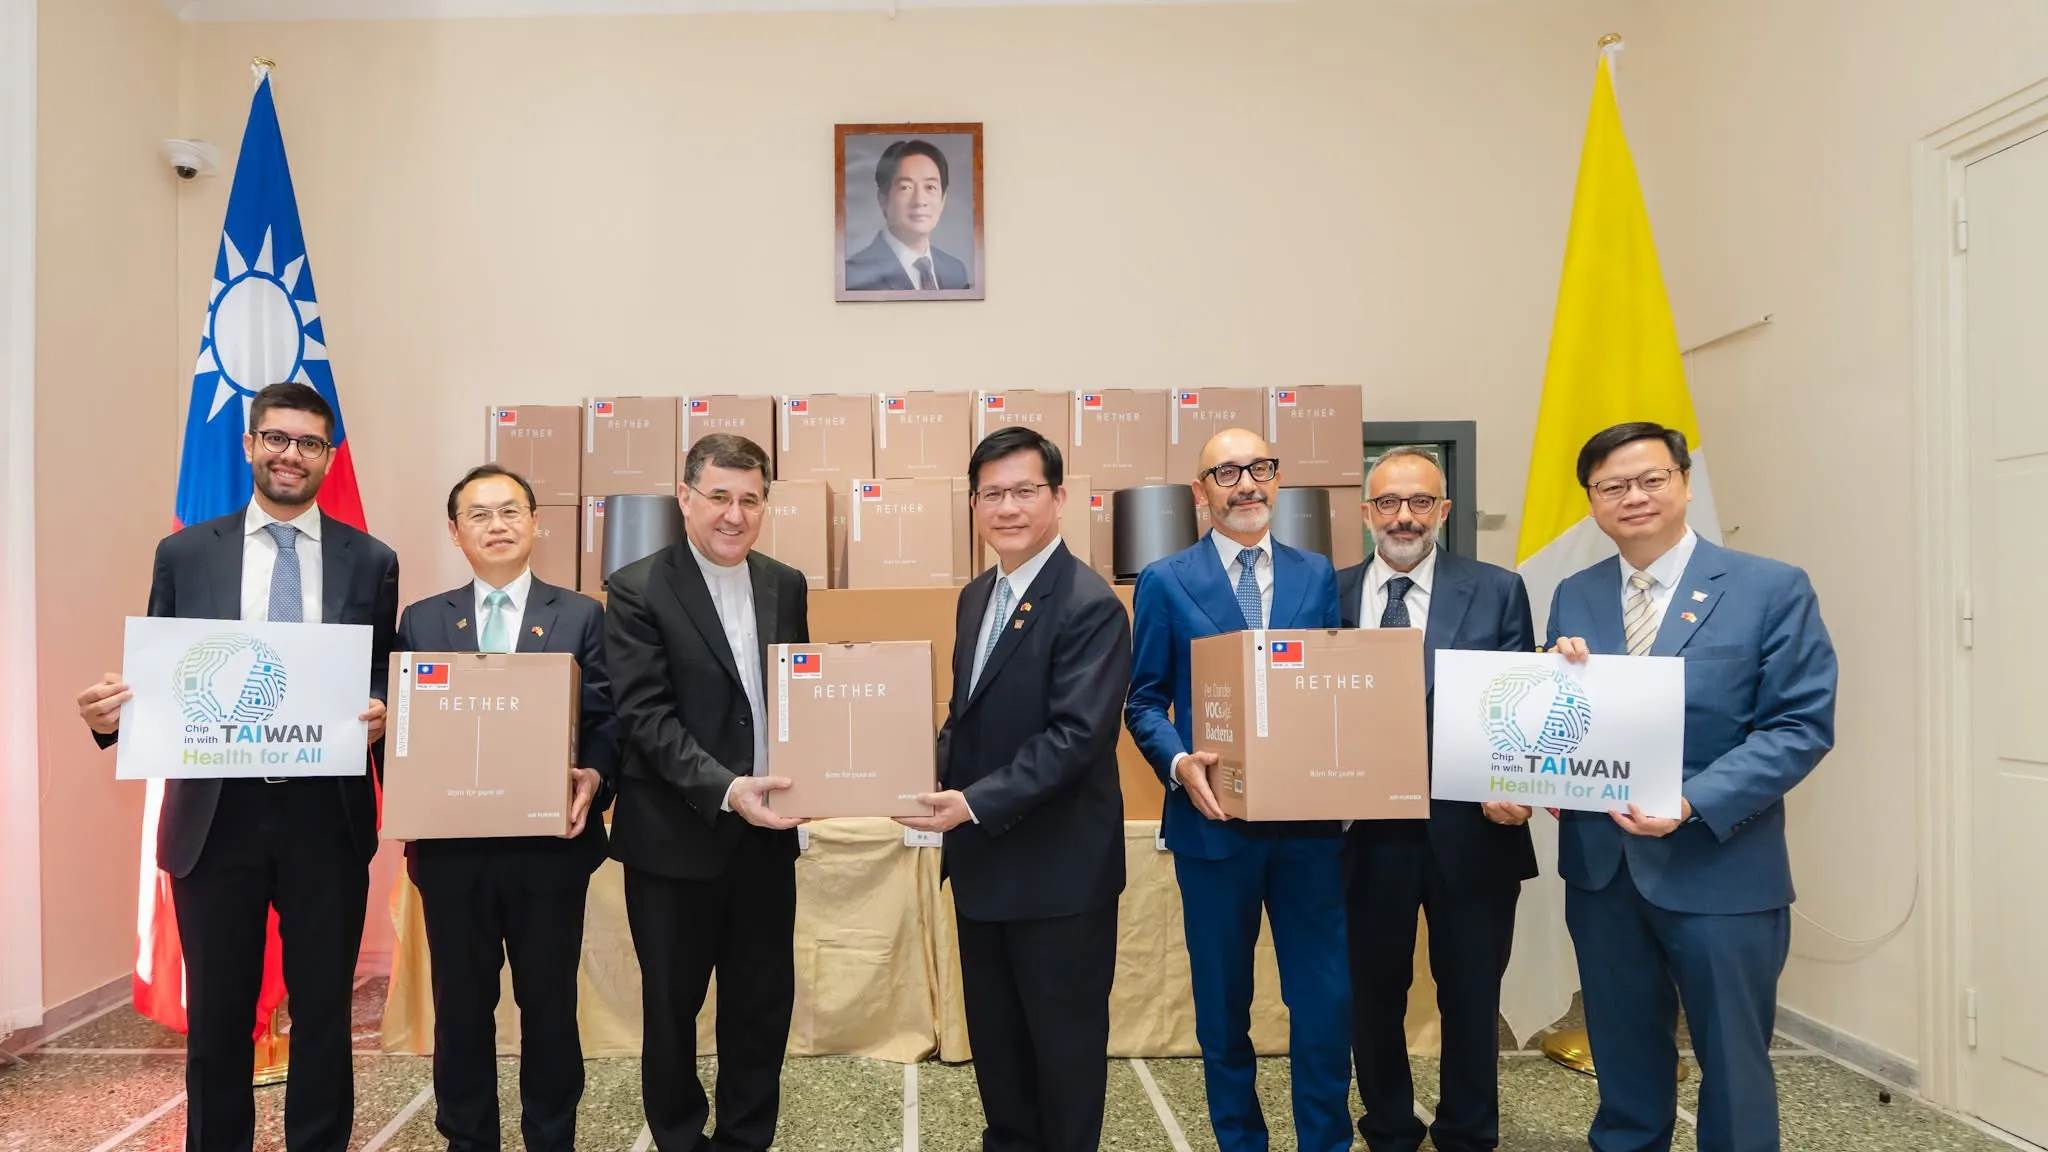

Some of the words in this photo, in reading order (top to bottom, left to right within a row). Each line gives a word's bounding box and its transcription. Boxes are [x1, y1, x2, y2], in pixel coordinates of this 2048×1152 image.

[767, 505, 799, 516] THER
[876, 503, 924, 514] AETHER
[1295, 674, 1375, 690] AETHER
[813, 683, 887, 699] AETHER
[439, 696, 520, 711] AETHER
[185, 724, 209, 735] Chip
[220, 724, 323, 743] TAIWAN
[1205, 722, 1233, 743] Bacteria
[184, 736, 194, 744] in
[196, 735, 218, 744] with
[183, 748, 253, 765] Health
[261, 748, 289, 764] for
[295, 747, 321, 763] All
[1492, 752, 1514, 762] Chip
[1491, 763, 1500, 772] in
[1502, 763, 1523, 773] with
[1525, 755, 1631, 779] TAIWAN
[1490, 776, 1557, 795] Health
[1565, 781, 1594, 797] for
[1601, 783, 1629, 800] All
